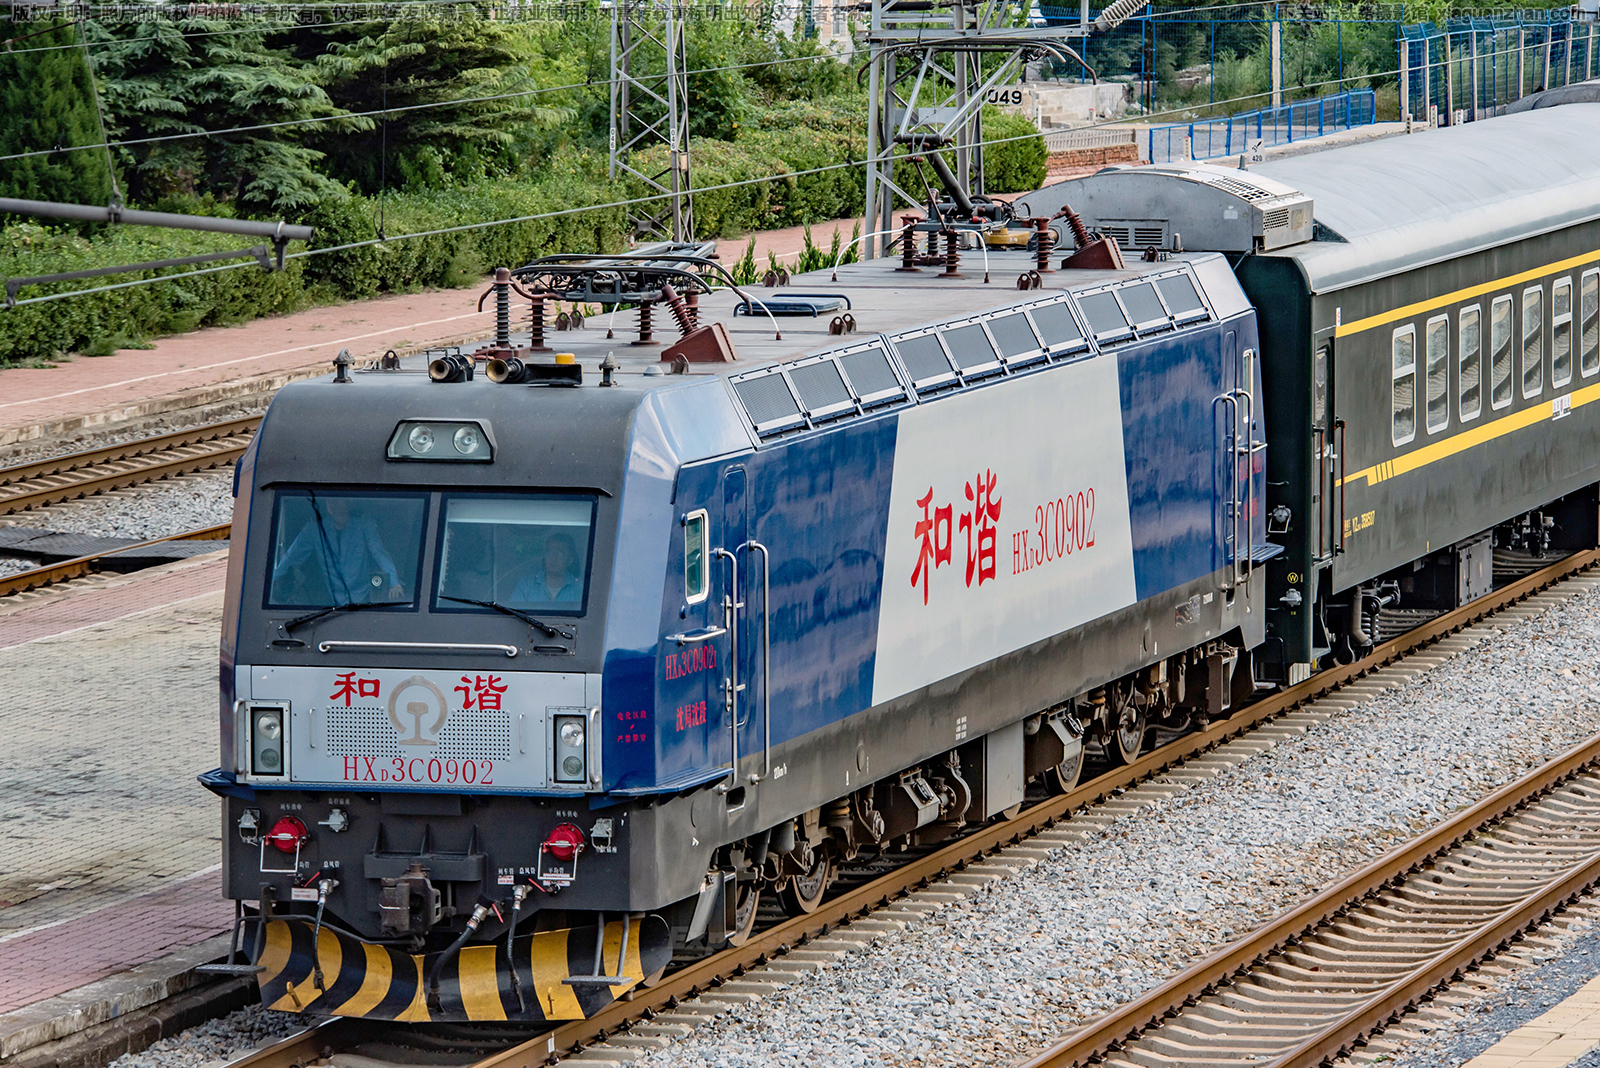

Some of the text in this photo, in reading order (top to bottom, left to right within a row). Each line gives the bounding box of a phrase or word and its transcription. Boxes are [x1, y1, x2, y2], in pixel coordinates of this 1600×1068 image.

[910, 468, 1002, 606] 和谐
[676, 701, 707, 732] 沈局沈段
